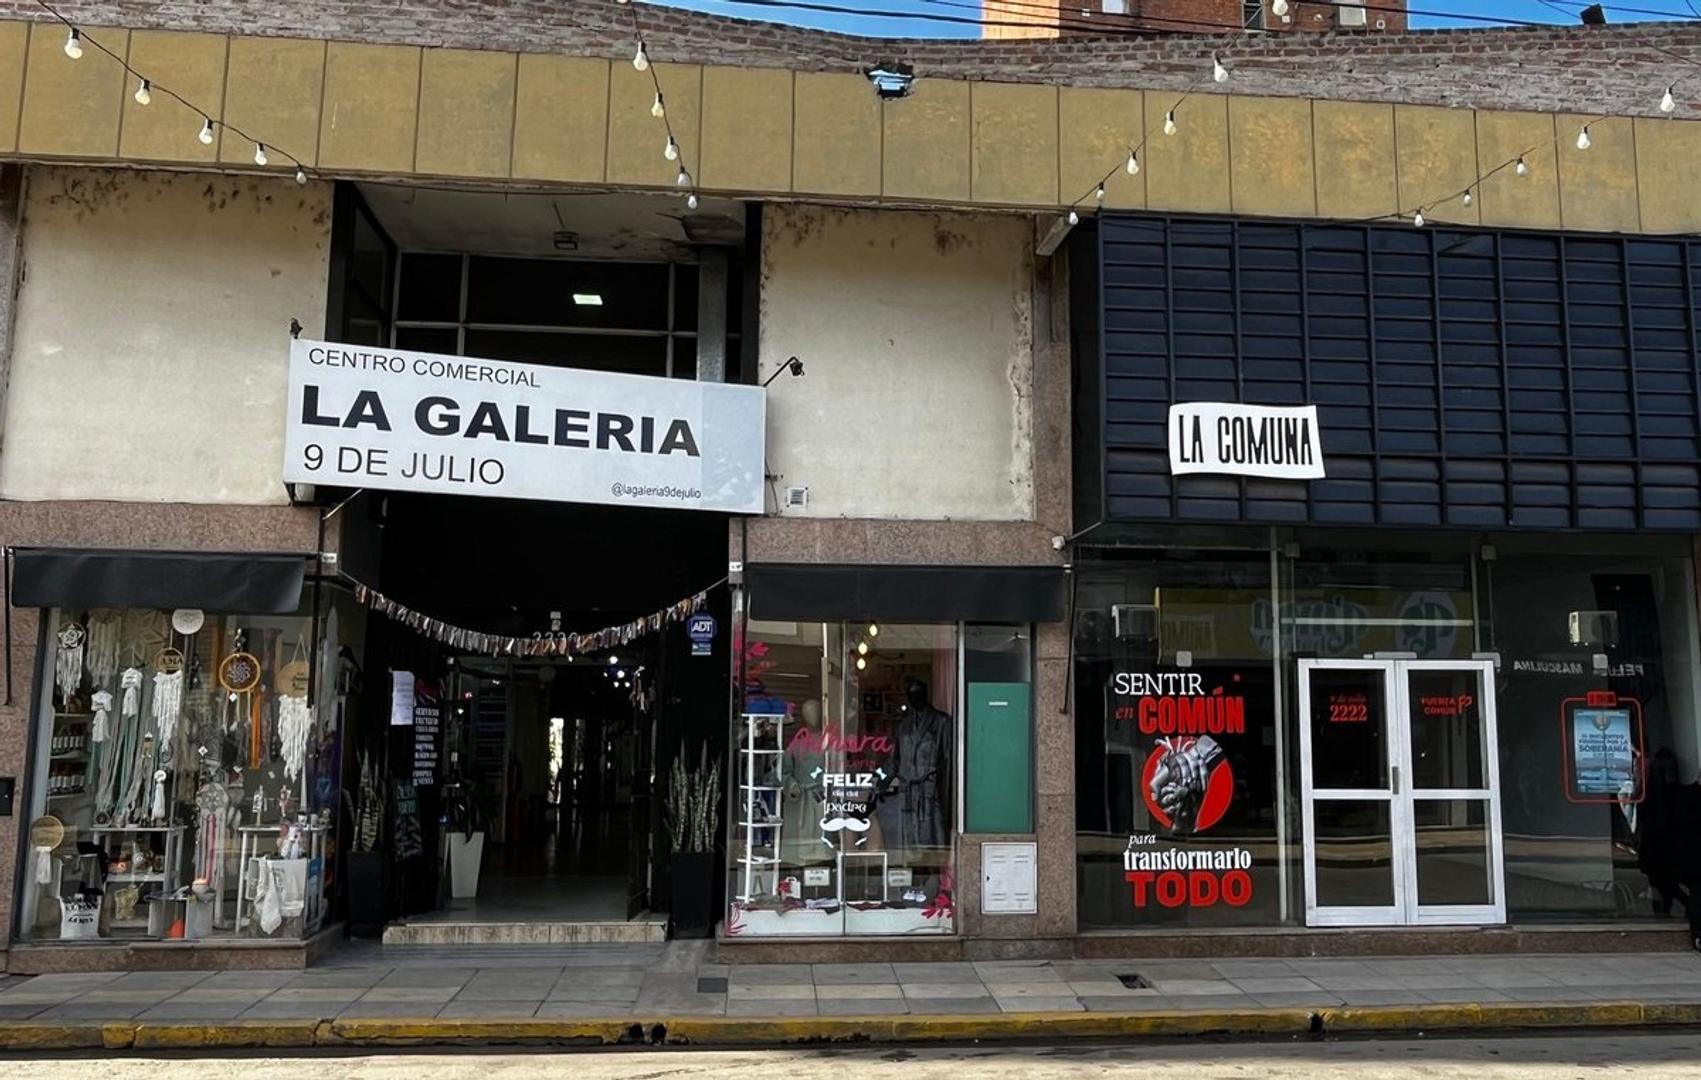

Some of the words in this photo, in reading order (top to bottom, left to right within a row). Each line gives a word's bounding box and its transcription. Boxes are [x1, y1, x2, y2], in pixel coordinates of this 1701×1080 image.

[309, 348, 406, 374] CENTRO
[413, 359, 541, 388] COMERCIAL
[301, 384, 393, 432] LA
[414, 395, 701, 457] GALERIA
[1178, 414, 1205, 464] LA
[1217, 416, 1314, 466] COMUNA
[303, 442, 324, 472] 9
[337, 446, 389, 476] DE
[401, 451, 505, 486] JULIO
[611, 481, 702, 500] @lagaleria9dejulio
[691, 620, 713, 633] ADT
[1114, 672, 1205, 696] SENTIR
[1114, 706, 1134, 720] en
[1138, 686, 1246, 734] COMÚN
[1329, 704, 1368, 722] 2222
[822, 772, 874, 787] FELIZ
[1128, 834, 1156, 849] para
[1123, 847, 1252, 871] transformarlo
[1125, 869, 1253, 908] TODO
